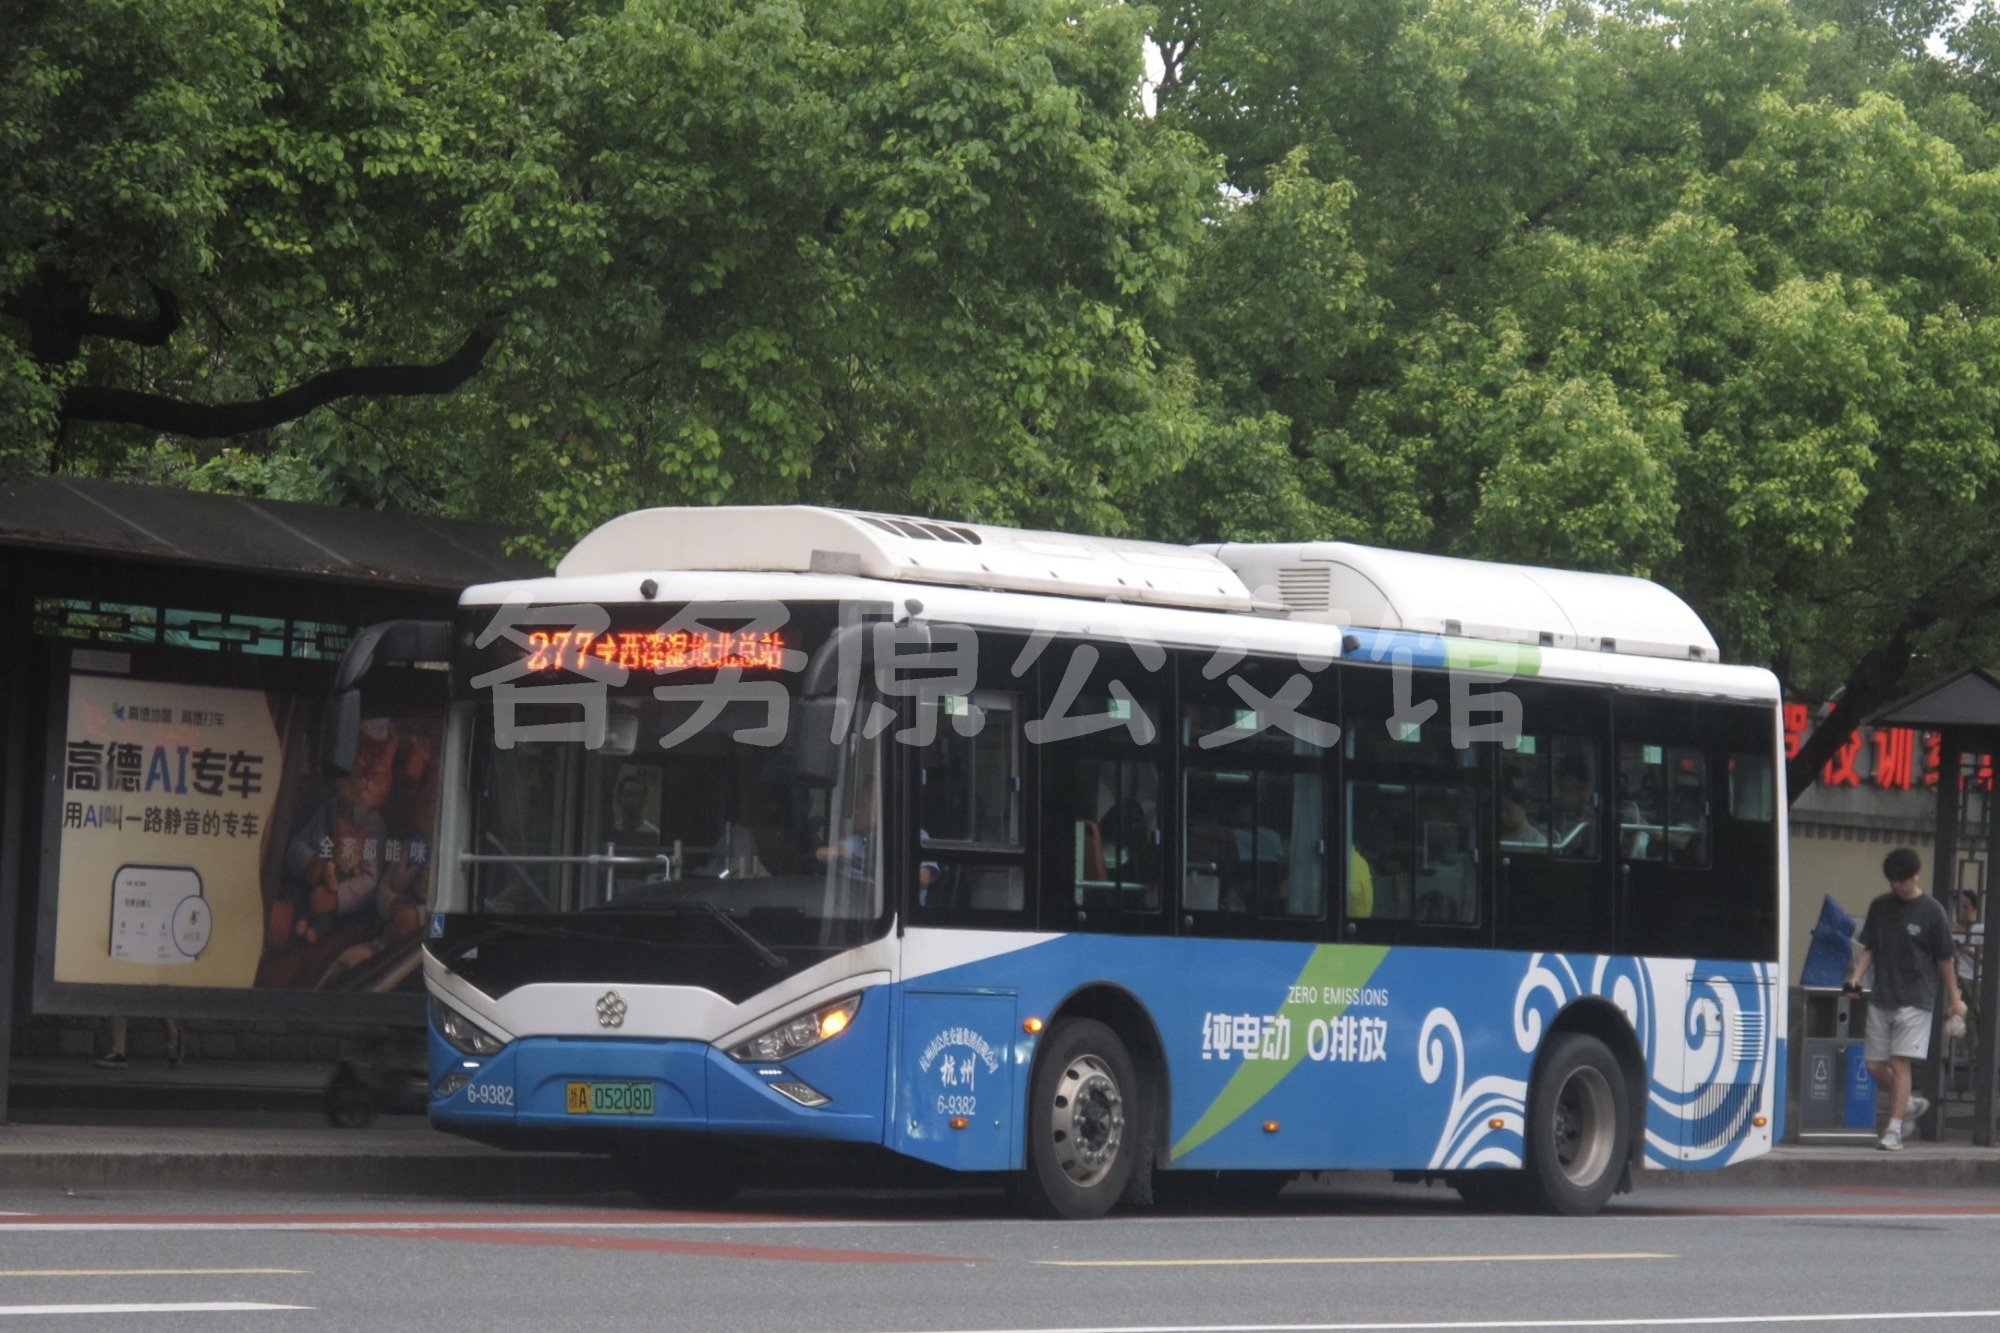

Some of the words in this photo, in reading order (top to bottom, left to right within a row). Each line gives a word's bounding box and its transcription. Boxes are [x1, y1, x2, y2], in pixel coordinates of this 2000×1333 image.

[527, 631, 596, 670] 277
[66, 739, 264, 799] 高德AI专车
[63, 802, 259, 839] 用AI叫一路静音的专车
[1288, 986, 1318, 1004] ZERO
[1323, 987, 1389, 1006] EMISSIONS
[1202, 1012, 1291, 1060] 纯电动
[940, 1052, 976, 1092] 杭州
[467, 1083, 514, 1106] 6-9382
[937, 1095, 976, 1115] 6-9382
